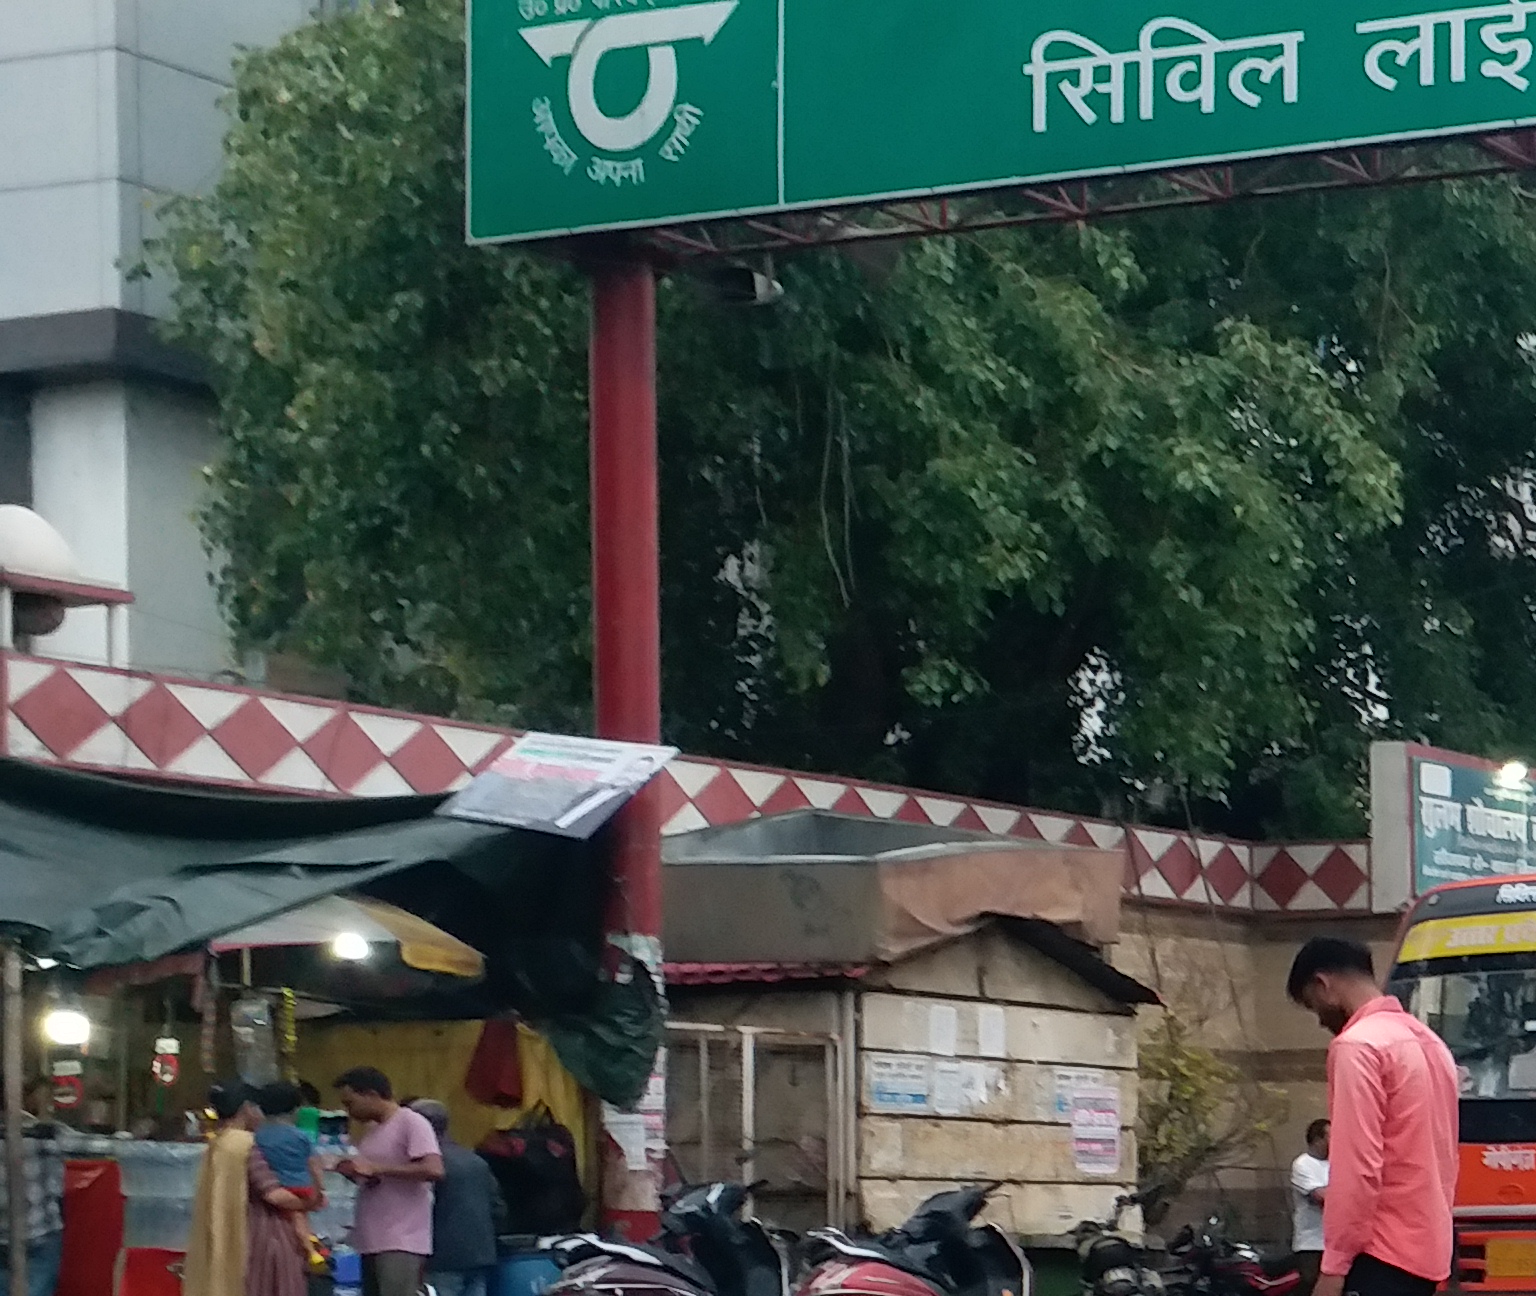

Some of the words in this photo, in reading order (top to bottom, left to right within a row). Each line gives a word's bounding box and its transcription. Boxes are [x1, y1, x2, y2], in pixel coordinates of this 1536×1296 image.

[1022, 15, 1305, 134] सिविल
[586, 155, 645, 187] अपना
[658, 102, 704, 162] साथी
